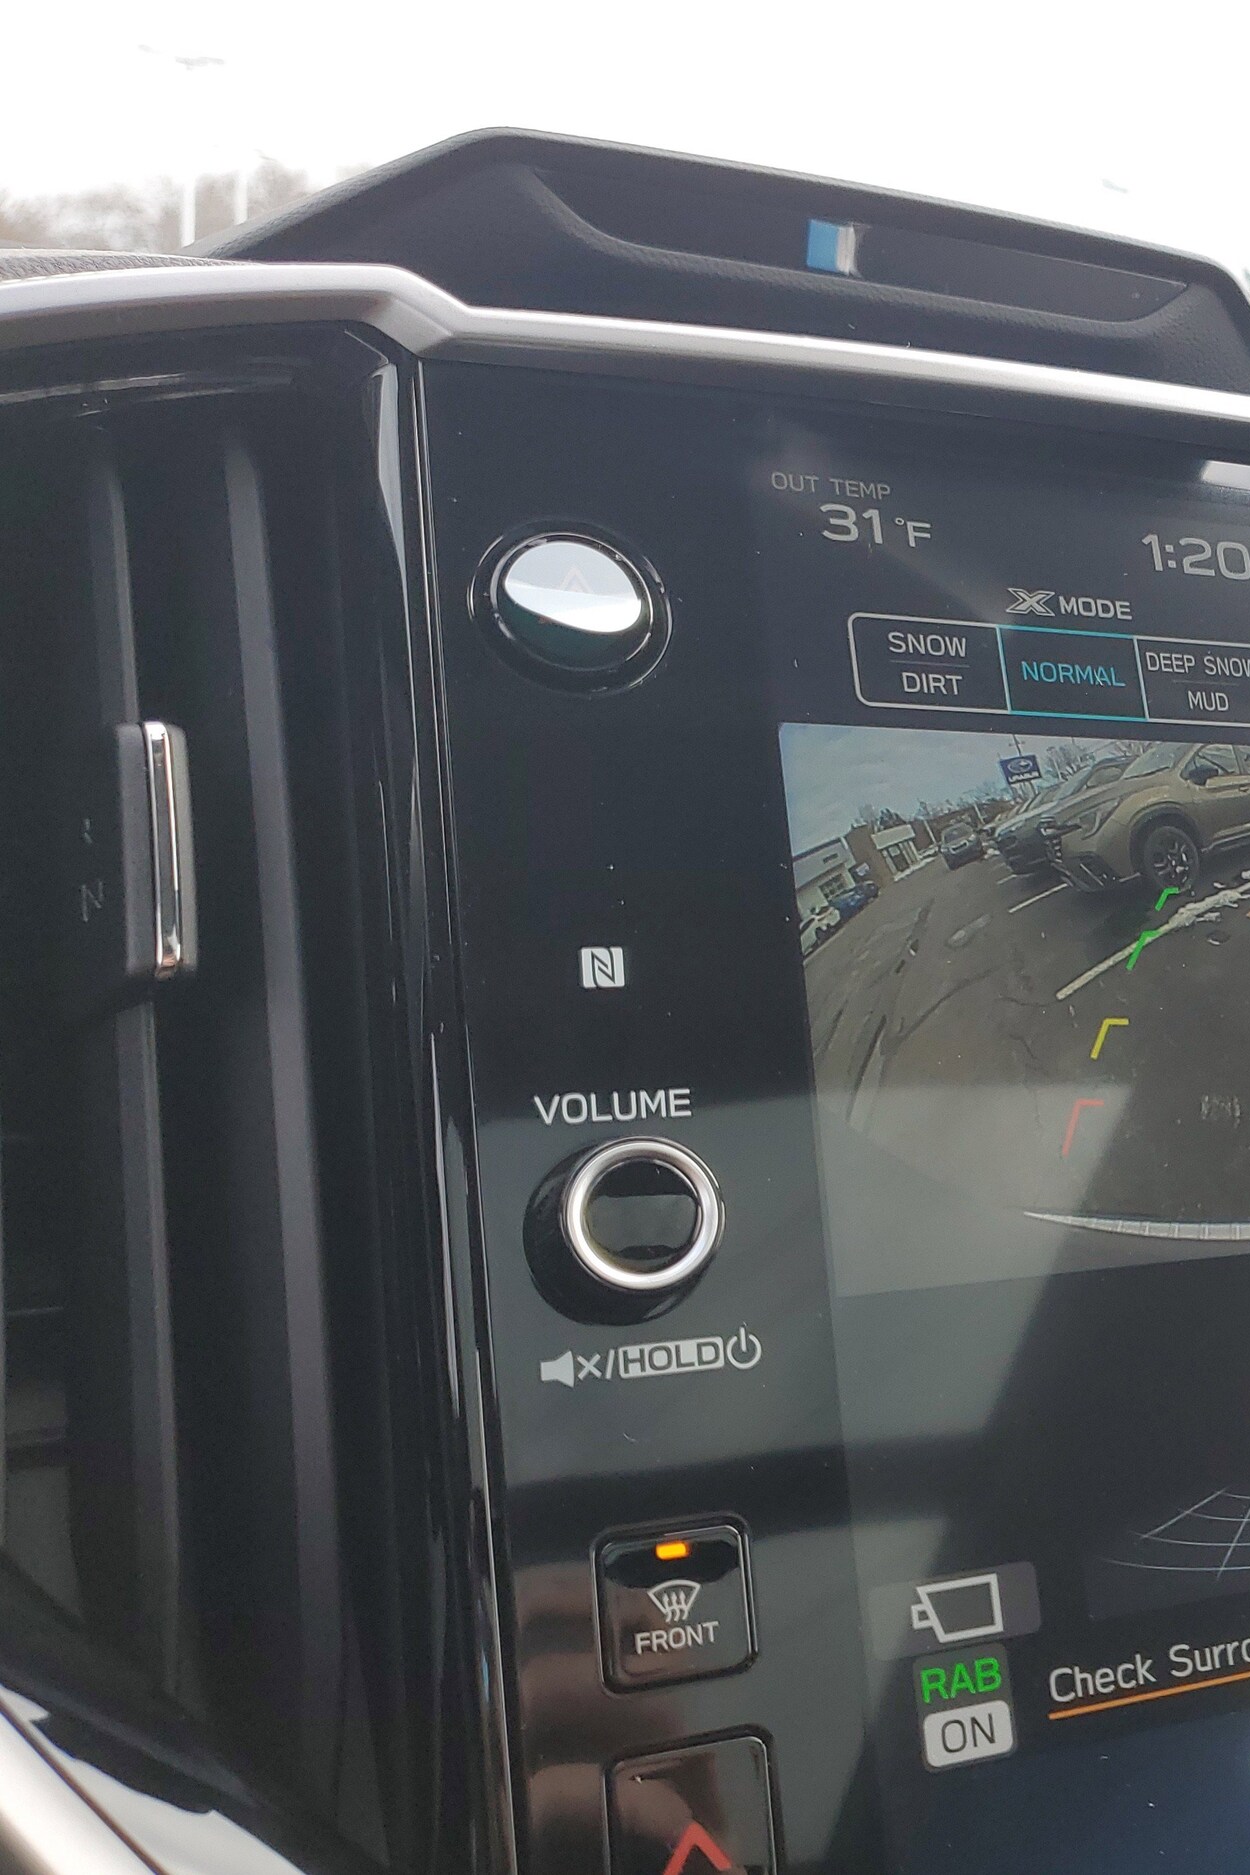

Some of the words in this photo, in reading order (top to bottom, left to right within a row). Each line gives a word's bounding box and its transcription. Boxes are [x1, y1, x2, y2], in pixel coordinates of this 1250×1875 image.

[771, 470, 818, 493] OUT
[829, 478, 891, 500] TEMP
[1059, 596, 1132, 621] MODE
[887, 631, 967, 659] SNOW
[1021, 661, 1126, 689] NORMAL
[1146, 651, 1196, 676] DEEP
[902, 671, 962, 697] DIRT
[1188, 690, 1229, 713] MUD
[534, 1088, 692, 1125] VOLUME
[634, 1620, 719, 1656] FRONT
[921, 1656, 1002, 1704] RAB
[1049, 1652, 1157, 1706] Check
[940, 1712, 997, 1755] ON
